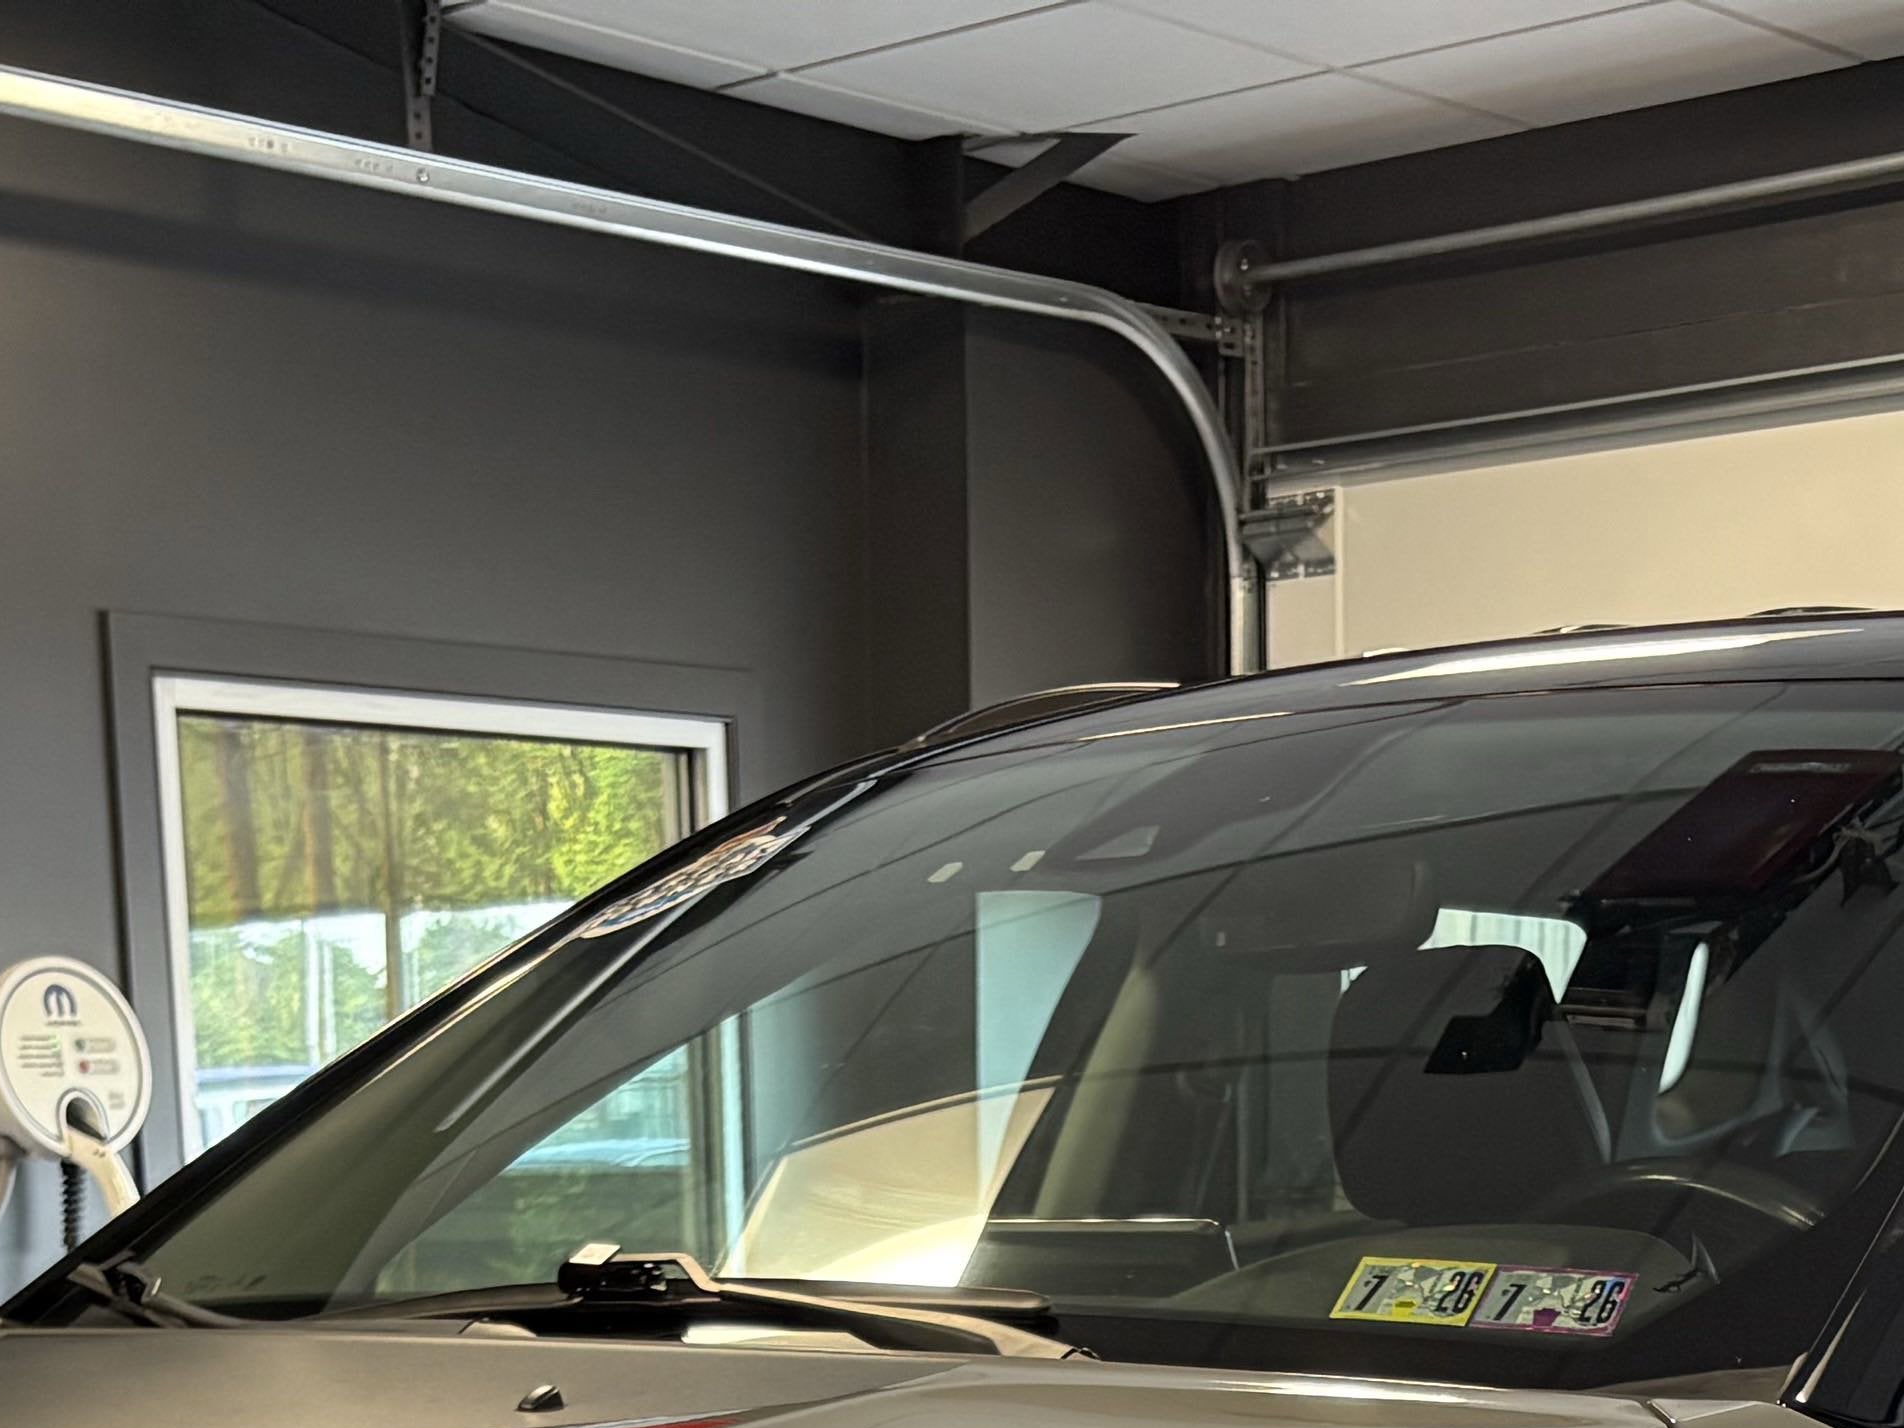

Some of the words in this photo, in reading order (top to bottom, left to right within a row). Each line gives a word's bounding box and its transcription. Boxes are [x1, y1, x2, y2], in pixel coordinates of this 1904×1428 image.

[1354, 1274, 1389, 1312] 7
[1434, 1271, 1485, 1315] 26
[1493, 1283, 1528, 1322] 7
[1579, 1279, 1626, 1326] 26
